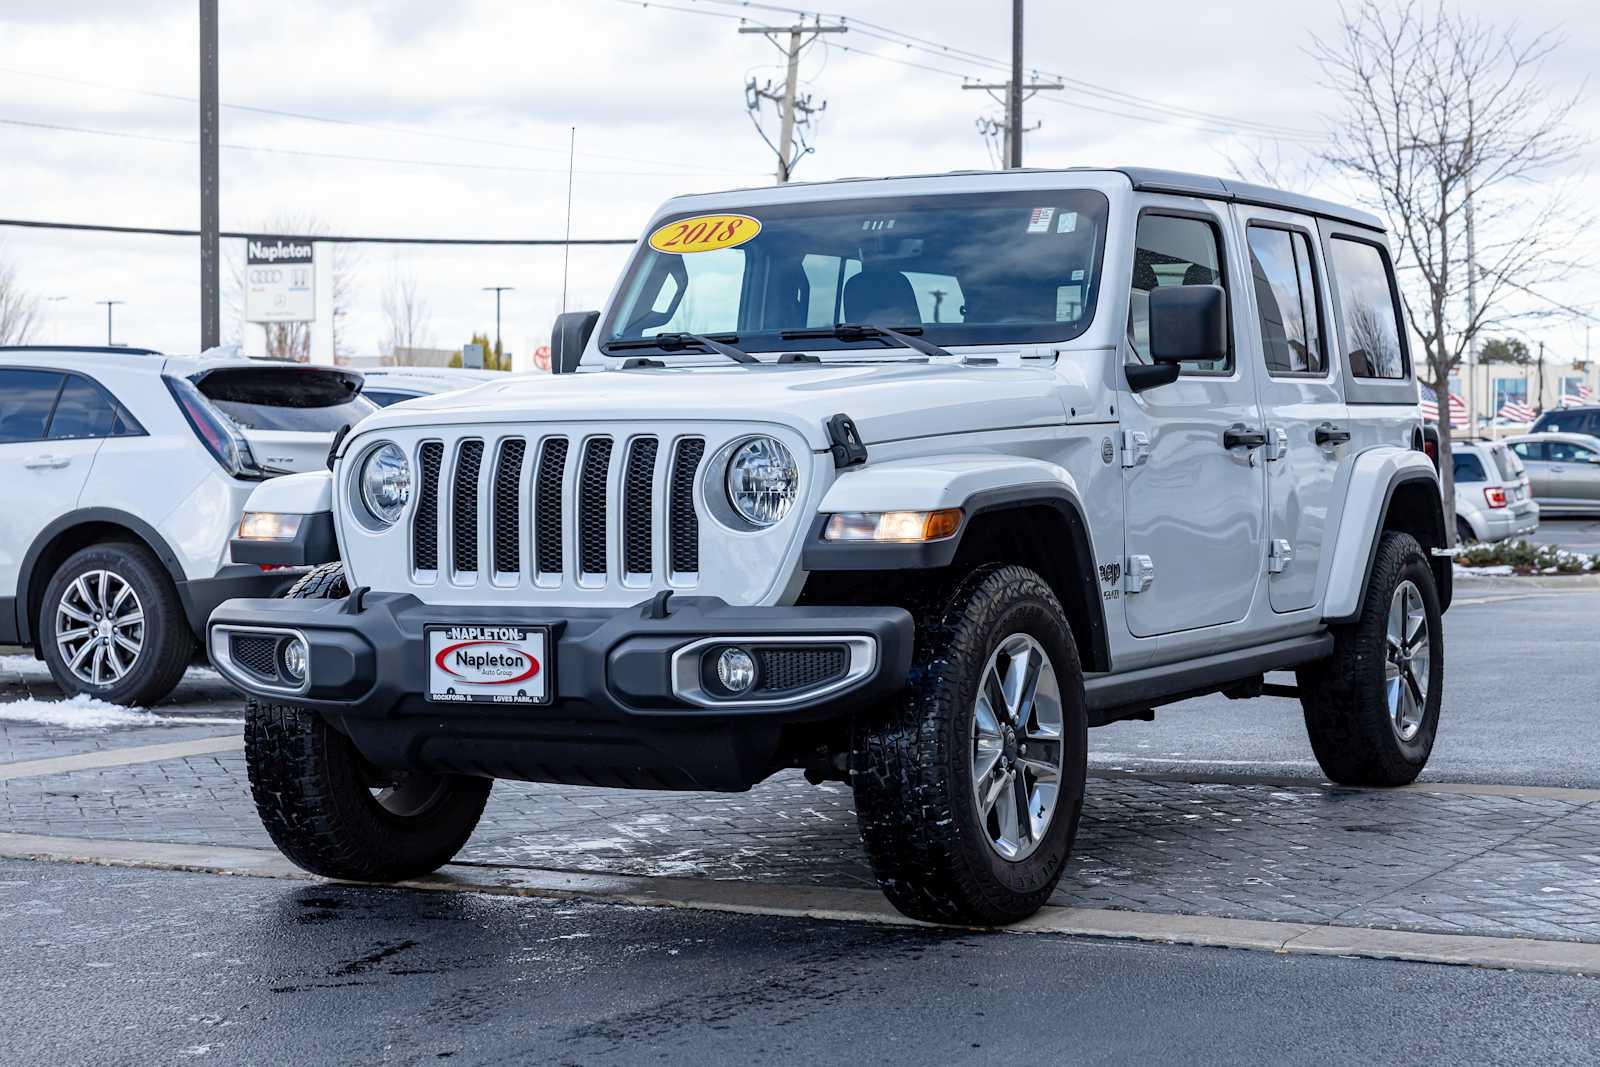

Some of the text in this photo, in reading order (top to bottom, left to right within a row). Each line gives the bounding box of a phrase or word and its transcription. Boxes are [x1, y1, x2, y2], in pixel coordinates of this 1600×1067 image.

[663, 219, 743, 246] 2018
[248, 240, 312, 262] Napleton
[451, 627, 519, 640] NAPLETON
[456, 651, 524, 669] Napleton
[481, 668, 513, 677] Auto Group
